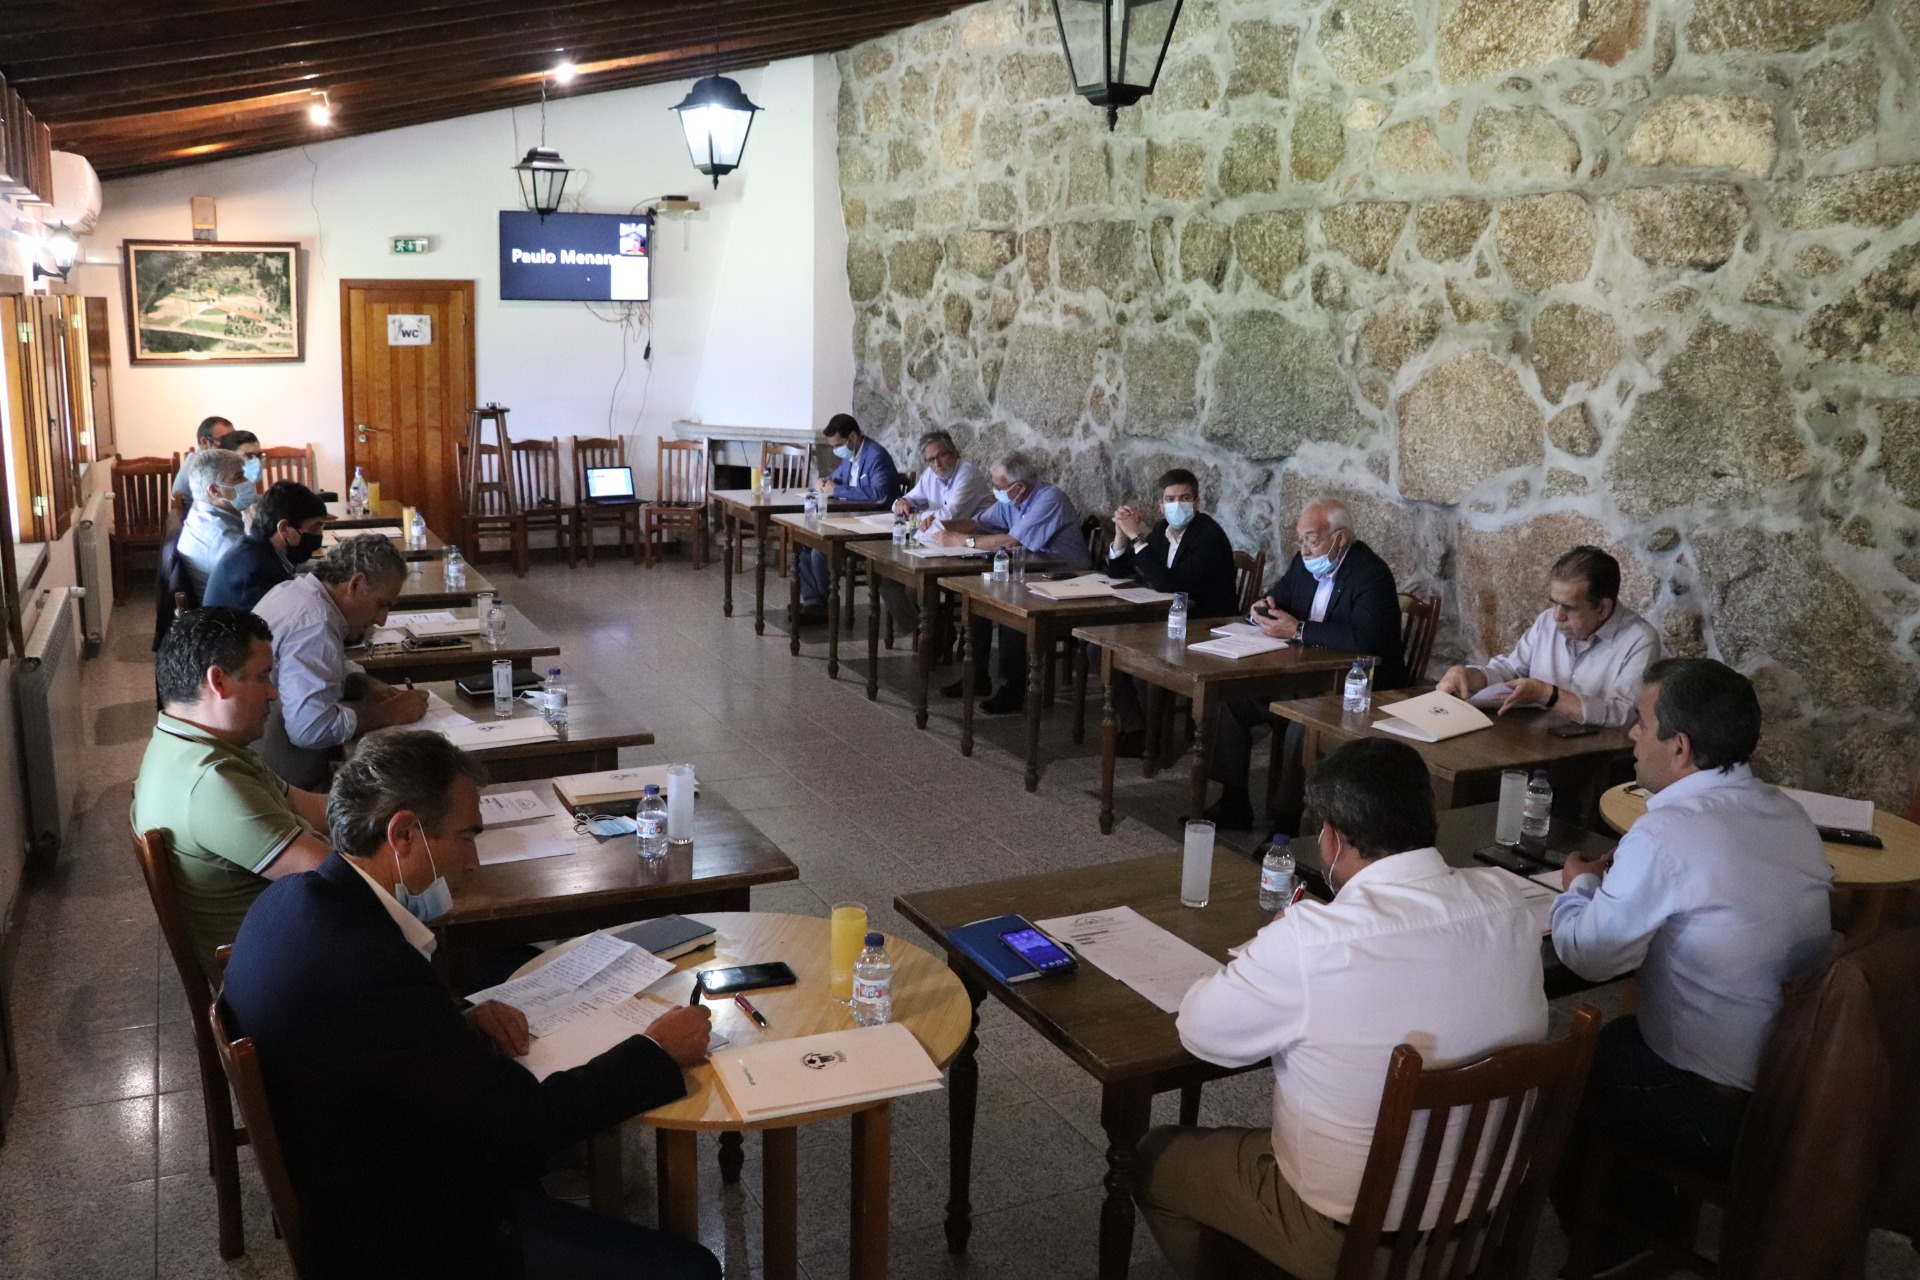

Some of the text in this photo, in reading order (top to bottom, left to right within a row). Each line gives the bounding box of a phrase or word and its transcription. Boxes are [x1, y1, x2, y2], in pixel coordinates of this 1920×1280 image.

[512, 248, 622, 265] Paulo Menan
[401, 329, 419, 338] WC
